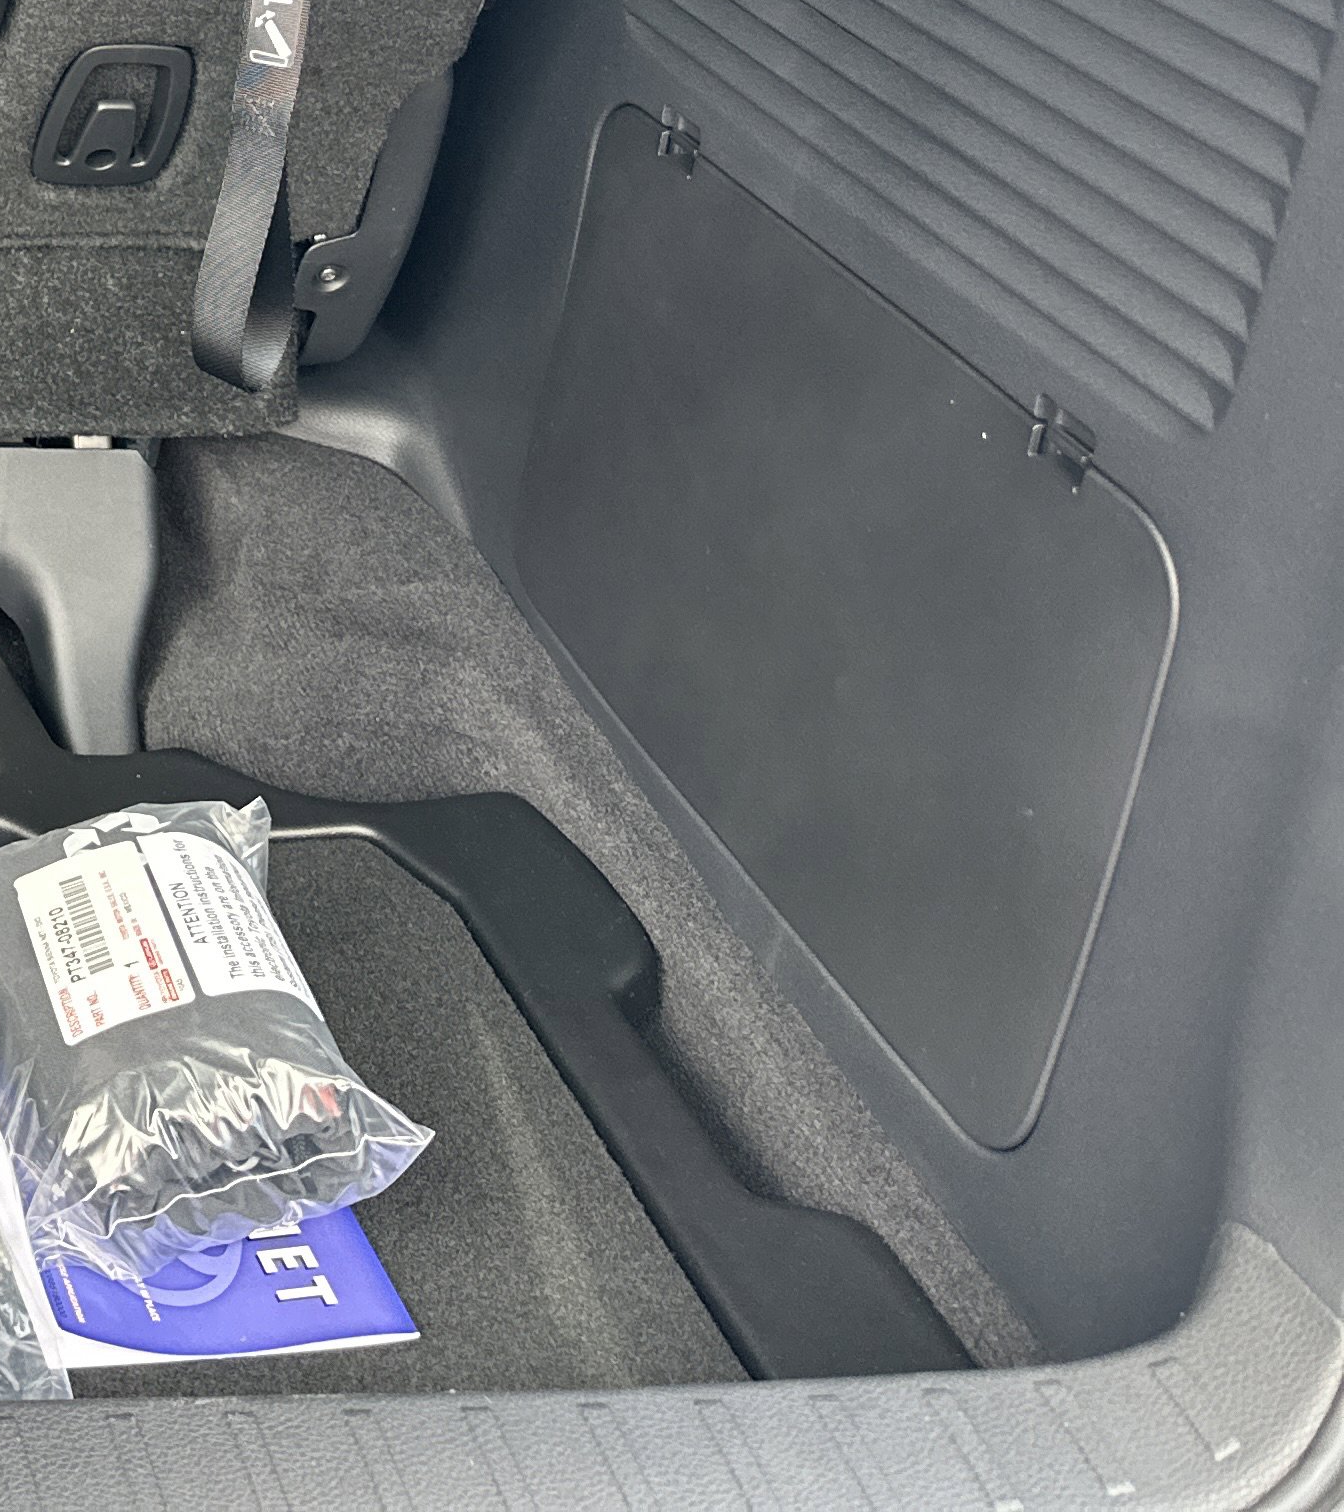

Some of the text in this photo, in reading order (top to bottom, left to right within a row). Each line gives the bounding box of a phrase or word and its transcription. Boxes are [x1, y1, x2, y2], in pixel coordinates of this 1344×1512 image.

[168, 882, 209, 944] ATTENTION
[172, 839, 245, 979] The installation instructions for
[218, 894, 233, 910] are
[48, 906, 87, 983] PT347-08210
[226, 910, 257, 958] accessory
[248, 959, 266, 978] this
